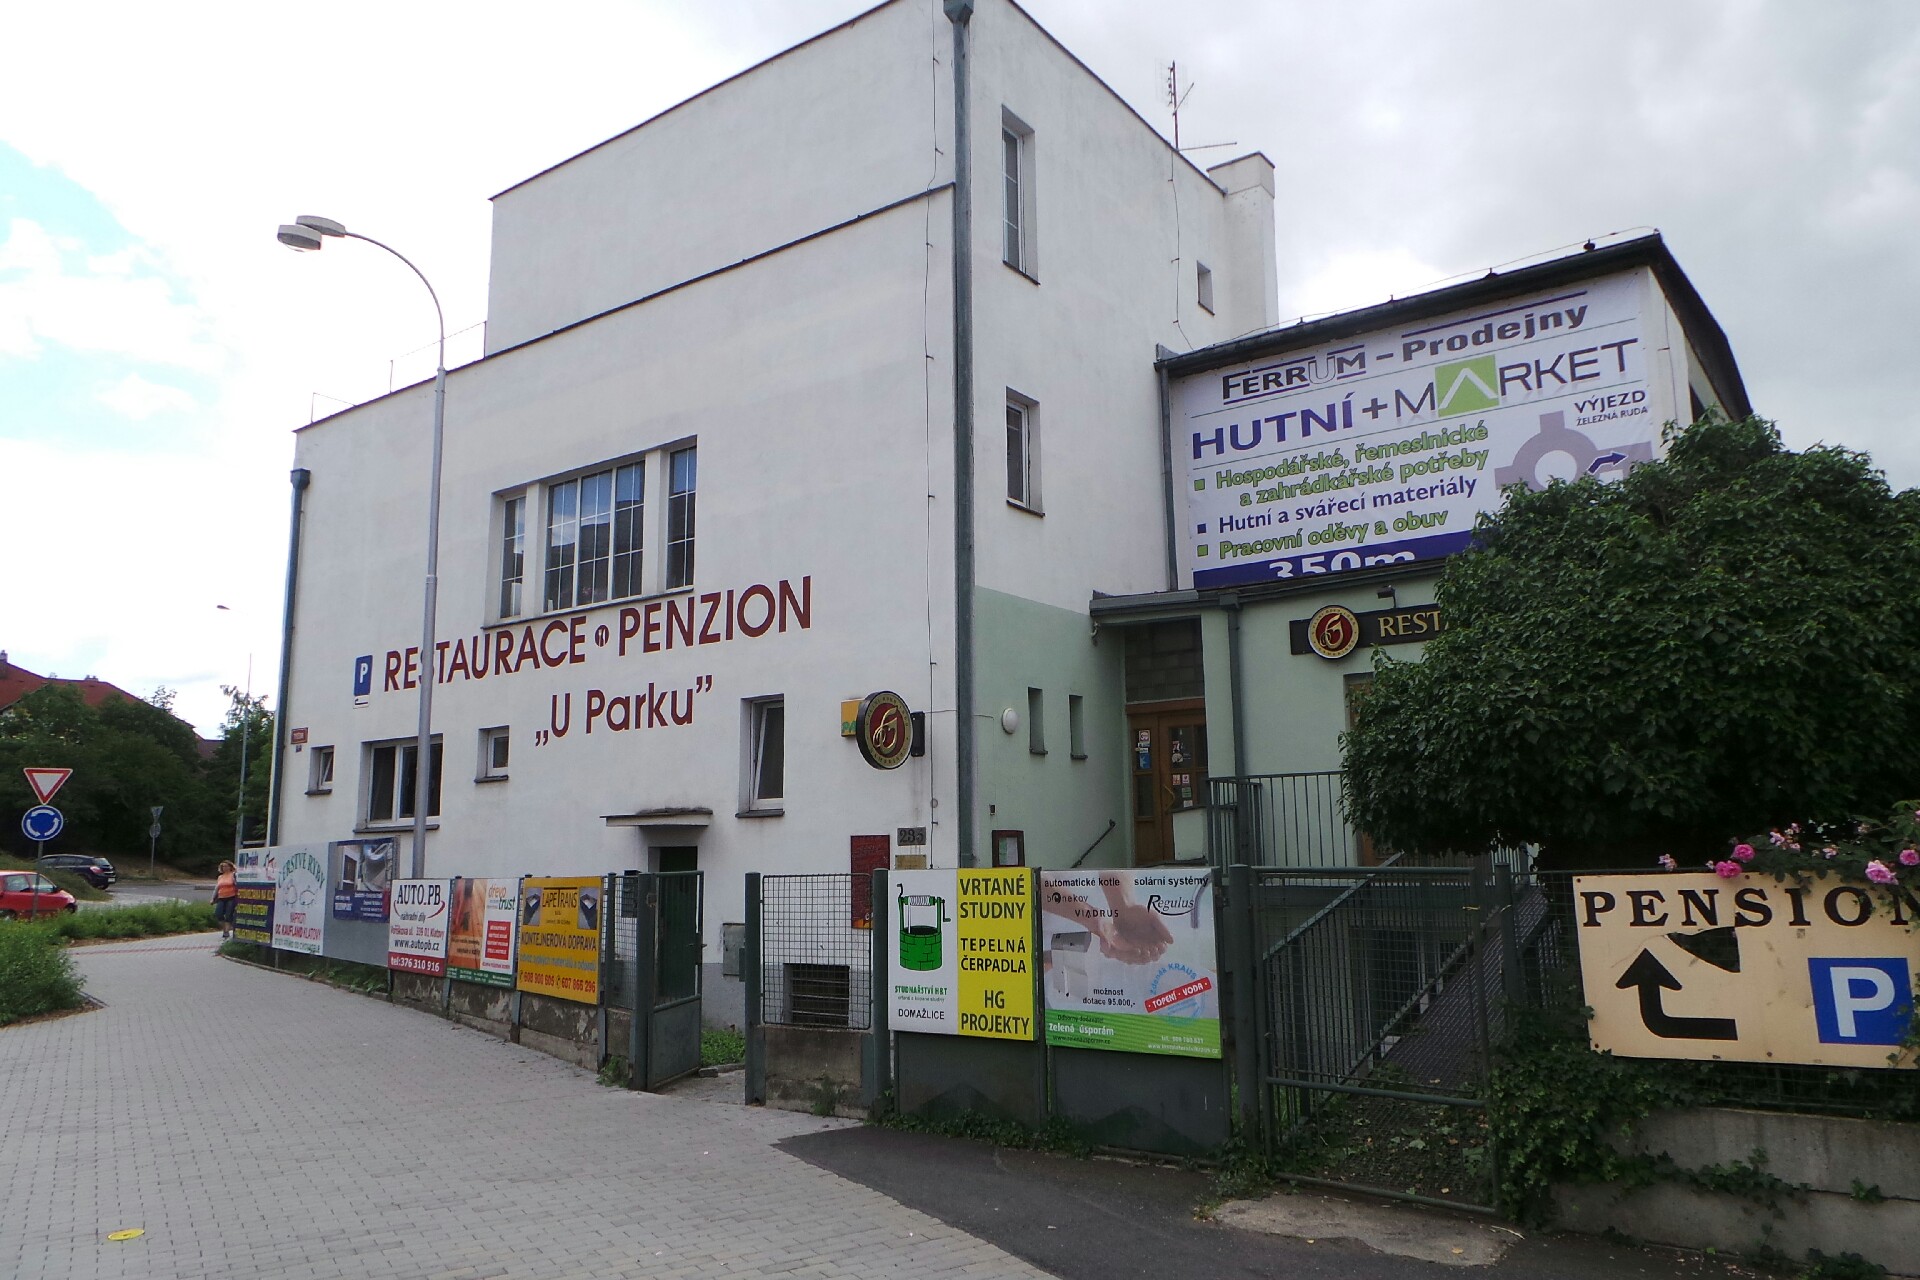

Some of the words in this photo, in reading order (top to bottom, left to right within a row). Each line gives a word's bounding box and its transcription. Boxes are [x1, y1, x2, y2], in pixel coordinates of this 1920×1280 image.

[1222, 351, 1366, 400] FERRUM
[1402, 304, 1588, 362] Prodejny
[1574, 389, 1647, 414] VÝJEZD
[1192, 391, 1355, 460] HUTNÍ
[1576, 408, 1619, 427] ŽELEZNÁ
[1620, 406, 1649, 419] RUDA
[1216, 448, 1350, 489] Hospodářské,
[1355, 420, 1489, 463] řemeslnické
[1240, 492, 1252, 506] a
[1256, 465, 1394, 505] zahrádkářské
[1400, 448, 1490, 483] potřeby
[1219, 508, 1273, 533] Hutní
[1278, 509, 1290, 523] a
[1295, 493, 1366, 521] svářecí
[1372, 475, 1478, 508] materiály
[1219, 528, 1303, 560] Pracovní
[1308, 521, 1369, 546] oděvy
[1374, 519, 1388, 536] a
[1393, 509, 1450, 532] obuv
[384, 615, 587, 693] RETAURACE
[618, 575, 812, 656] PENZION
[1377, 610, 1449, 638] REST
[359, 662, 369, 684] P
[959, 873, 1026, 896] VRTANÉ
[1044, 877, 1096, 887] automatické
[1098, 877, 1121, 886] kotle
[1134, 876, 1166, 886] solární
[1168, 875, 1209, 888] systémy
[396, 884, 442, 906] AUTO.PB
[498, 896, 516, 911] trust
[542, 887, 578, 909] LAPETRANS
[1147, 894, 1196, 914] Regulus
[959, 901, 1026, 919] STUDNY
[1074, 909, 1119, 919] VIADRUS
[394, 939, 440, 953] www.autopb.cz
[520, 930, 567, 949] KONTEJNEROVÁ
[567, 934, 597, 951] DOPRAVA
[960, 936, 1026, 953] TEPELNÁ
[413, 959, 426, 970] 310
[427, 961, 440, 972] 916
[960, 955, 1027, 974] ČERPADLA
[1167, 962, 1198, 980] KRAUS
[894, 984, 934, 995] STUDNAŘSTVÍ
[984, 989, 1005, 1009] HG
[1093, 987, 1124, 996] možnost
[1151, 990, 1177, 1009] TOPENÍ
[1182, 982, 1204, 996] VODA
[1082, 997, 1106, 1006] dotace
[1829, 966, 1895, 1038] P
[898, 1007, 945, 1020] DOMAŽLICE
[961, 1012, 1030, 1036] PROJEKTY
[1048, 1022, 1075, 1033] zelená
[1079, 1022, 1114, 1036] úsporám
